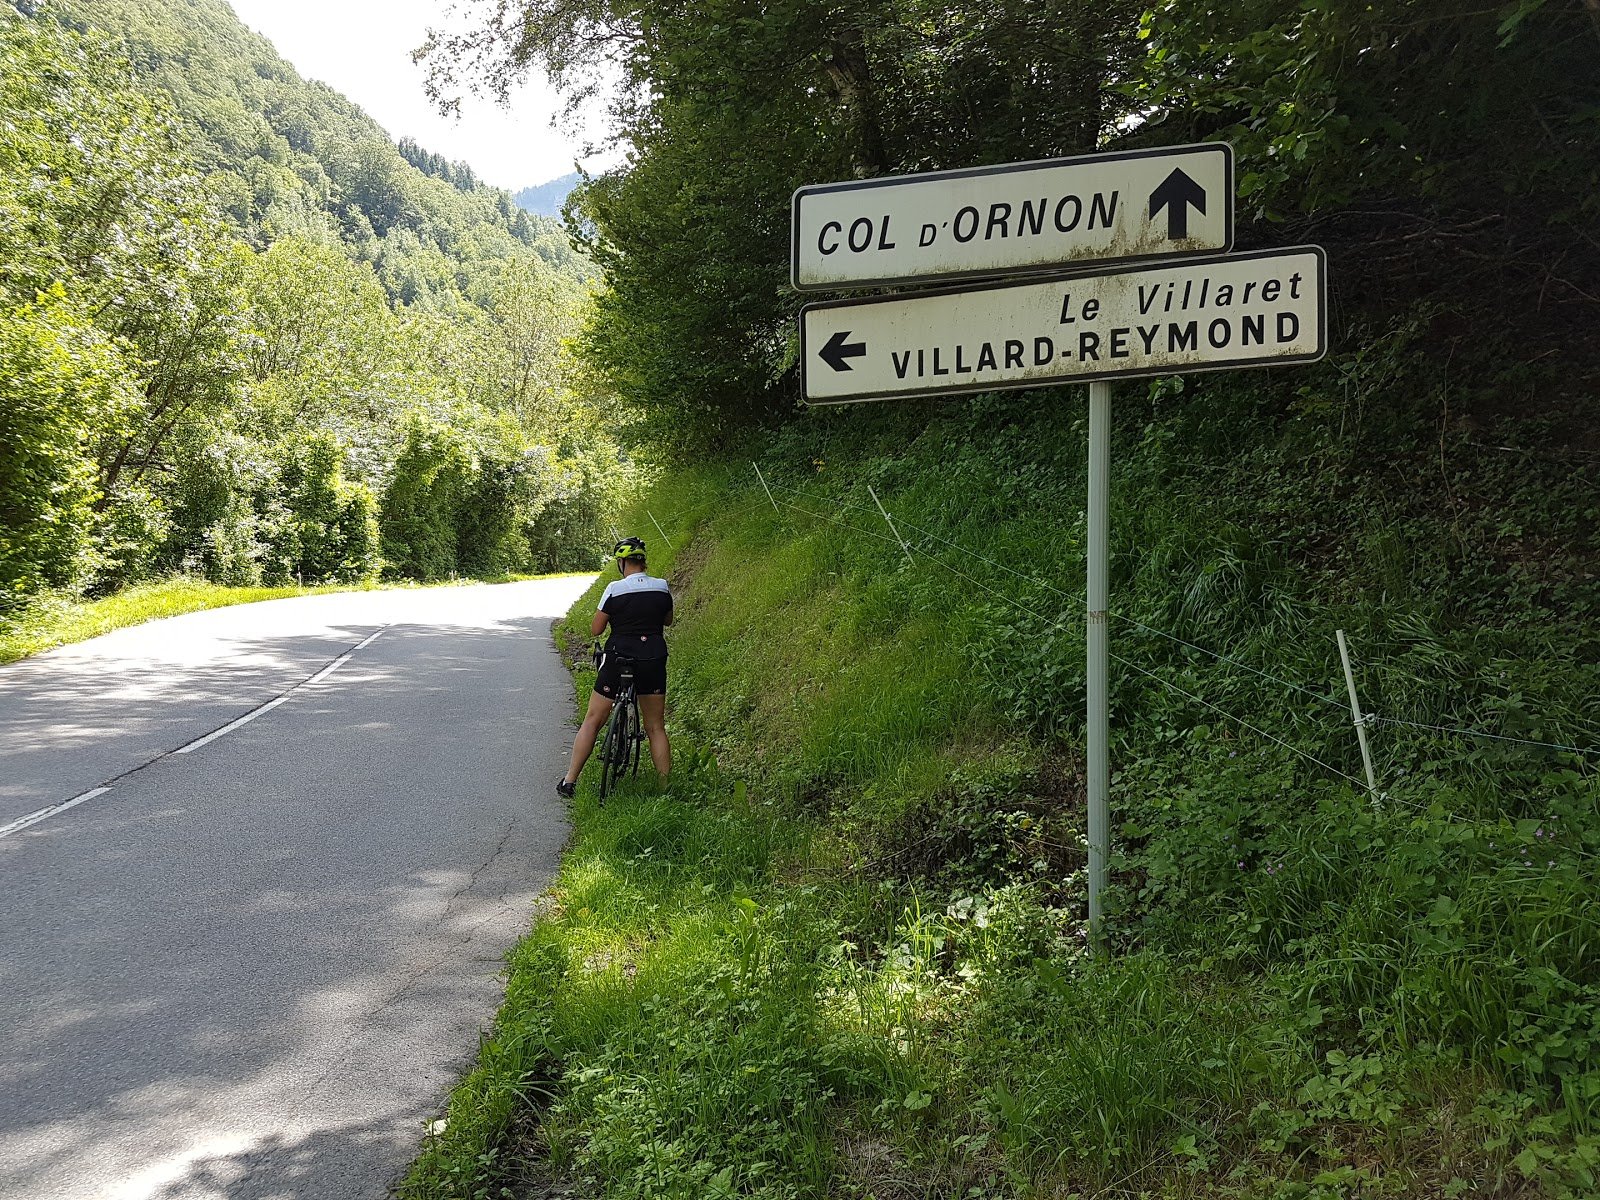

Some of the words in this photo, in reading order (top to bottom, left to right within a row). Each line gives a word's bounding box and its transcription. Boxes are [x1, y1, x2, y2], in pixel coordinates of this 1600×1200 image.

[818, 215, 896, 256] COL
[1059, 294, 1100, 325] Le
[1138, 272, 1302, 315] Villaret
[892, 312, 1300, 379] VILLARD-REYMOND
